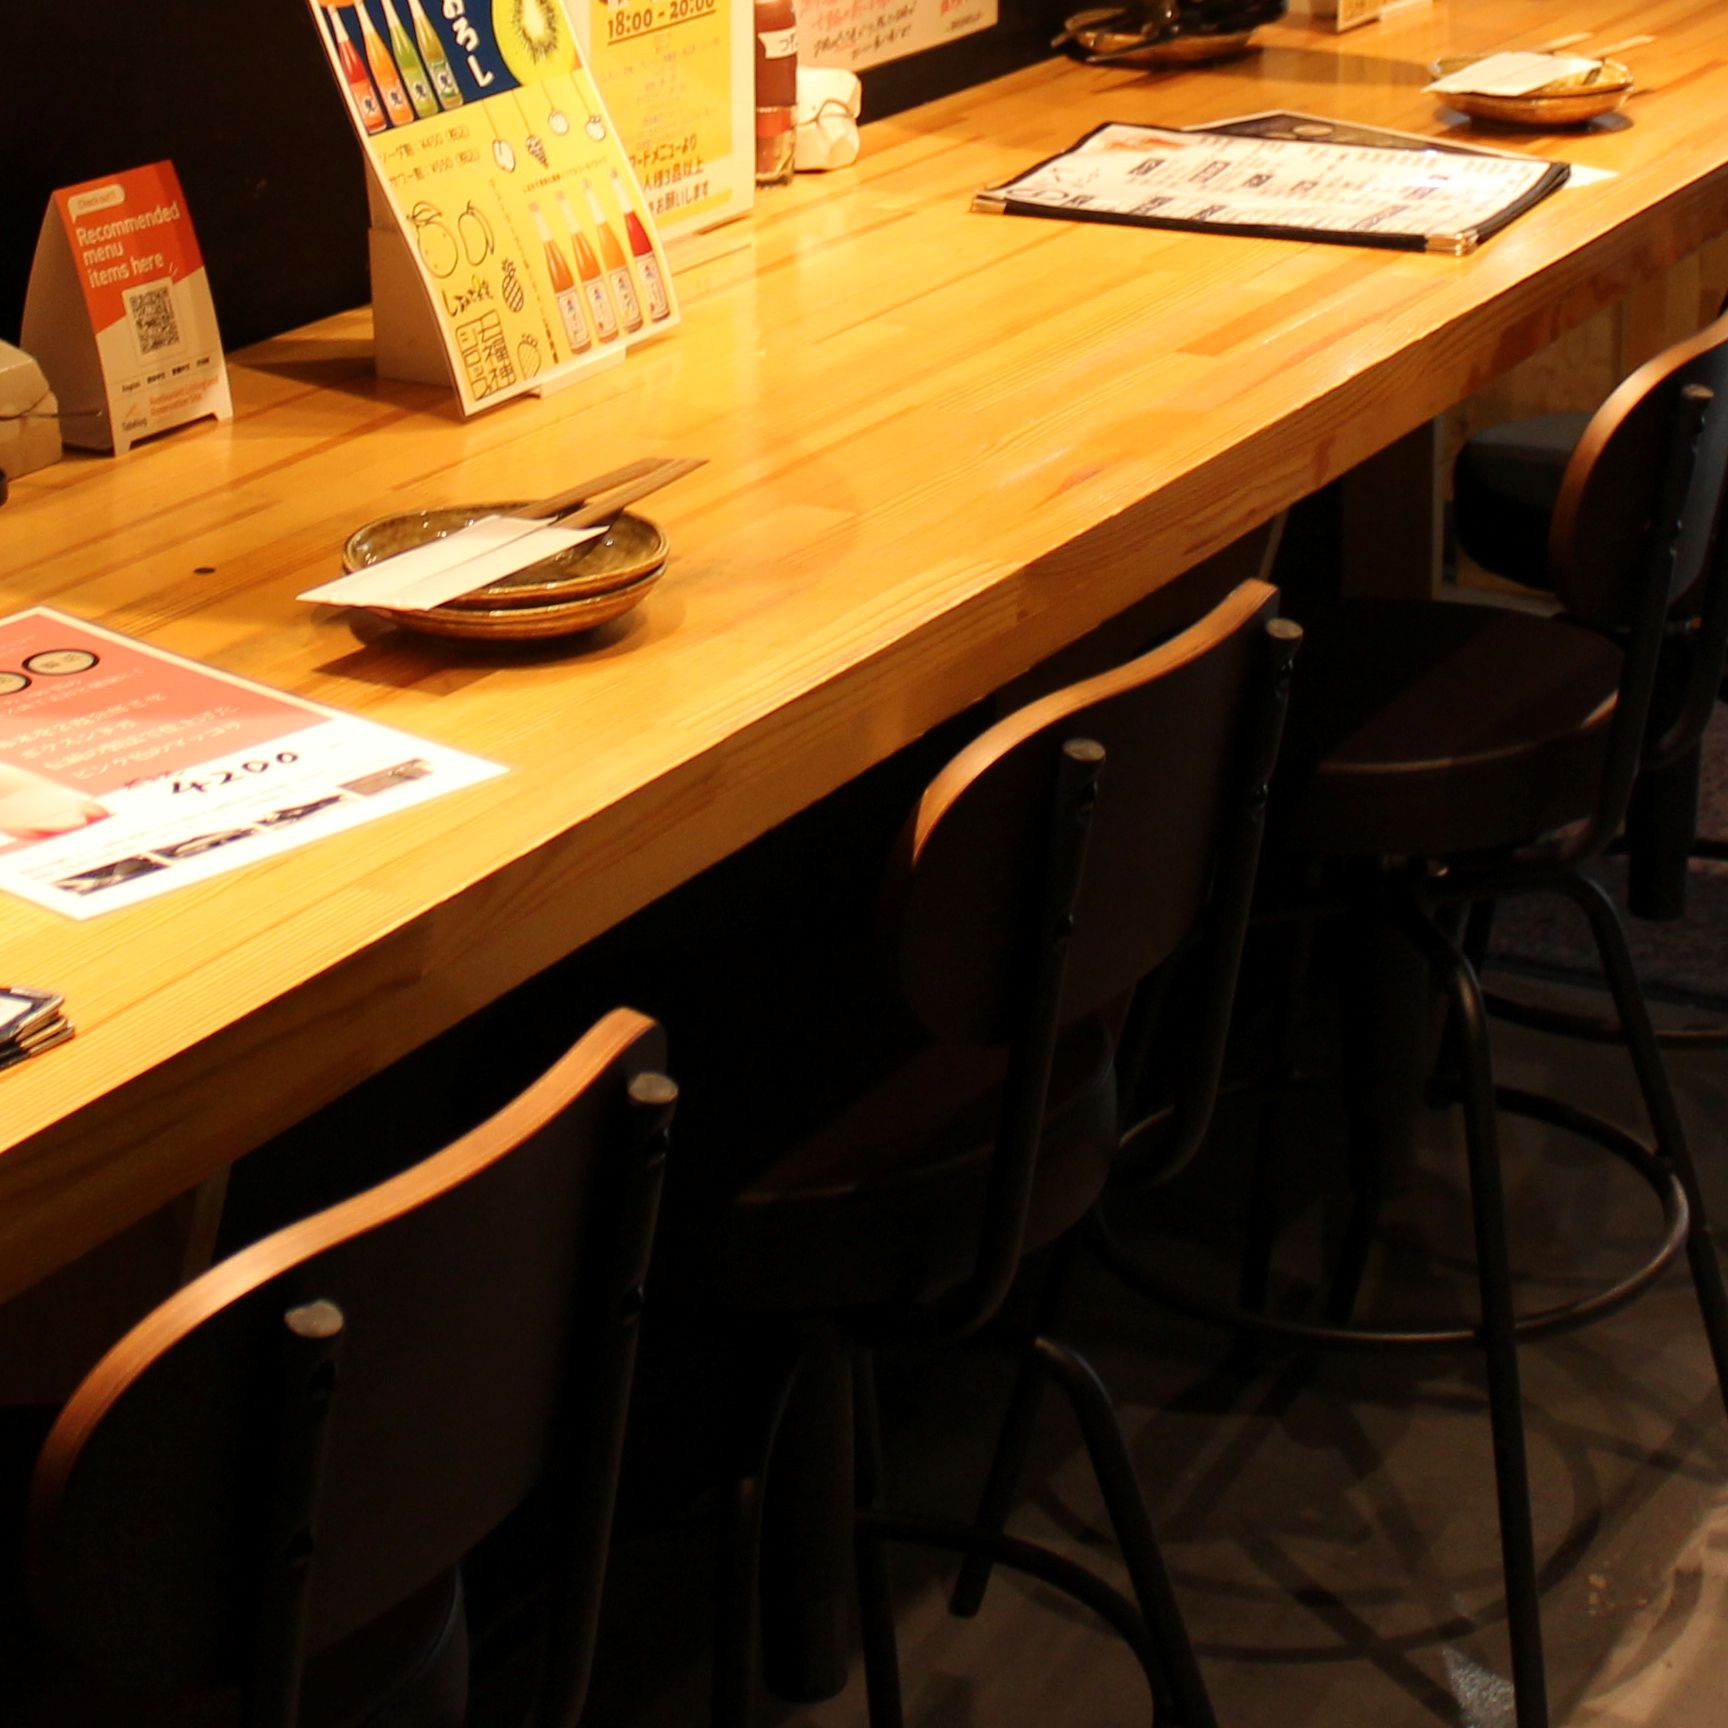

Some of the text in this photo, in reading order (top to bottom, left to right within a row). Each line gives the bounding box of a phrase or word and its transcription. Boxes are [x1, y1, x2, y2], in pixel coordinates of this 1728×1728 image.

[608, 9, 653, 39] 18:00
[75, 200, 181, 248] Recommended
[83, 242, 124, 267] menu
[87, 252, 165, 290] items here
[171, 750, 299, 796] 4200
